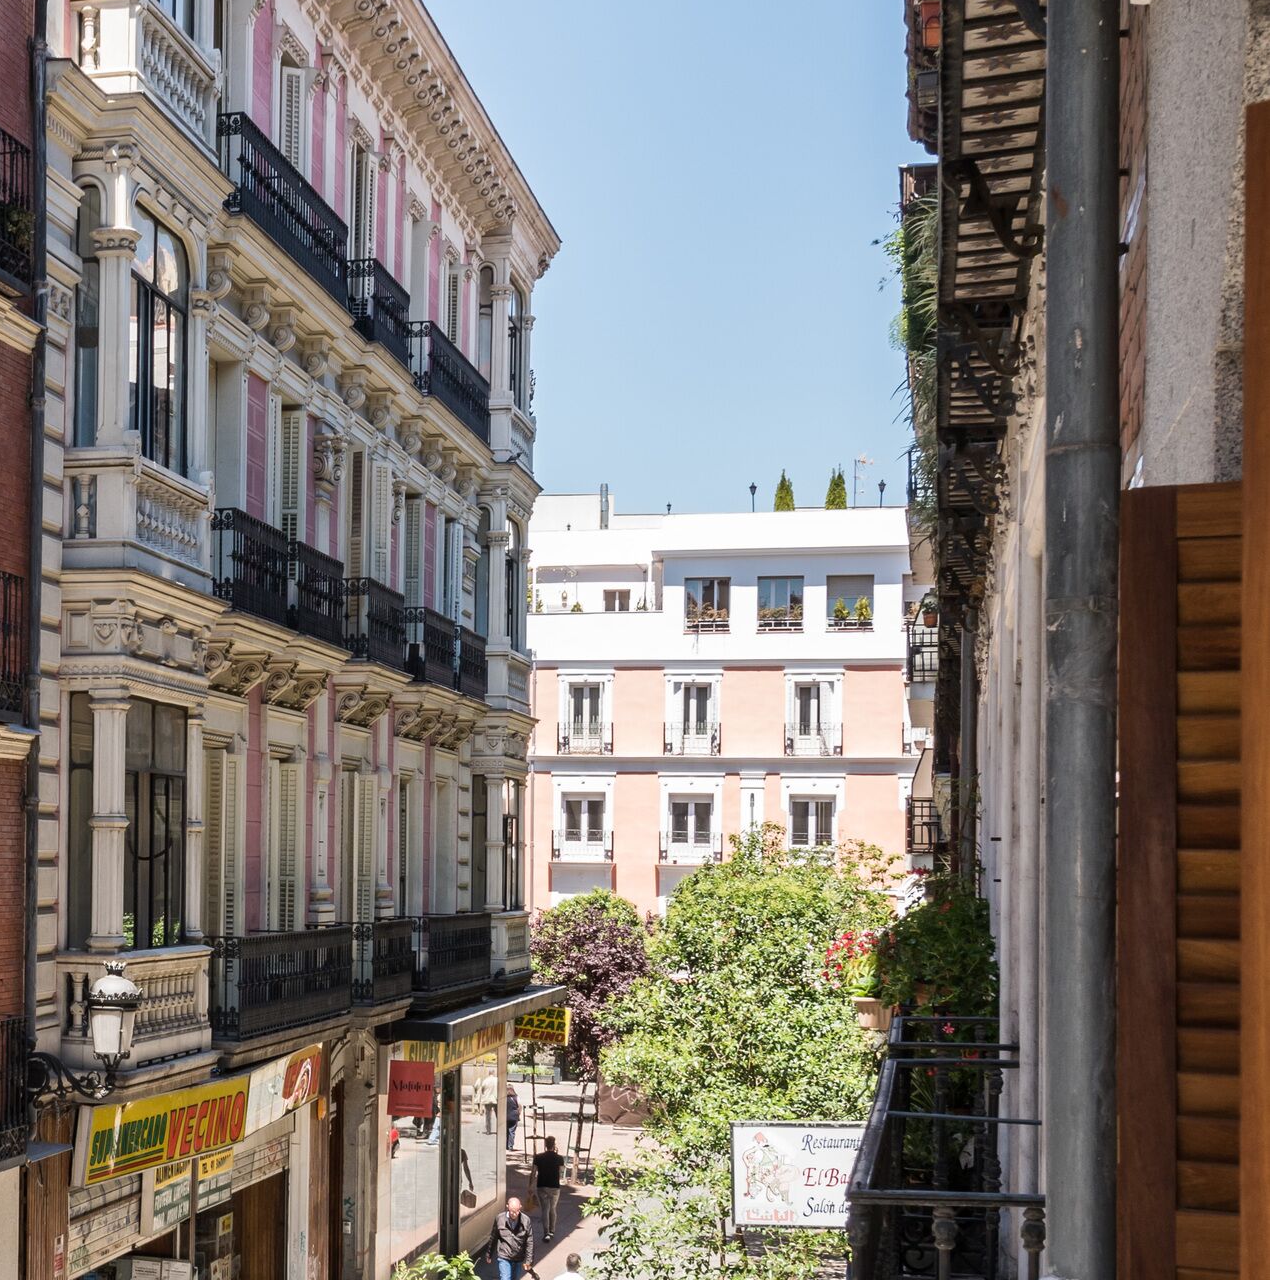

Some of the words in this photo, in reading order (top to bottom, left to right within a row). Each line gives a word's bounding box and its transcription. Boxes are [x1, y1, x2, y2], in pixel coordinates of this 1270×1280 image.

[515, 1017, 565, 1032] BAZAR
[515, 1027, 565, 1042] VECINO
[90, 1111, 168, 1166] SUPMERCADO
[166, 1091, 246, 1160] VECINO
[803, 1167, 822, 1187] El
